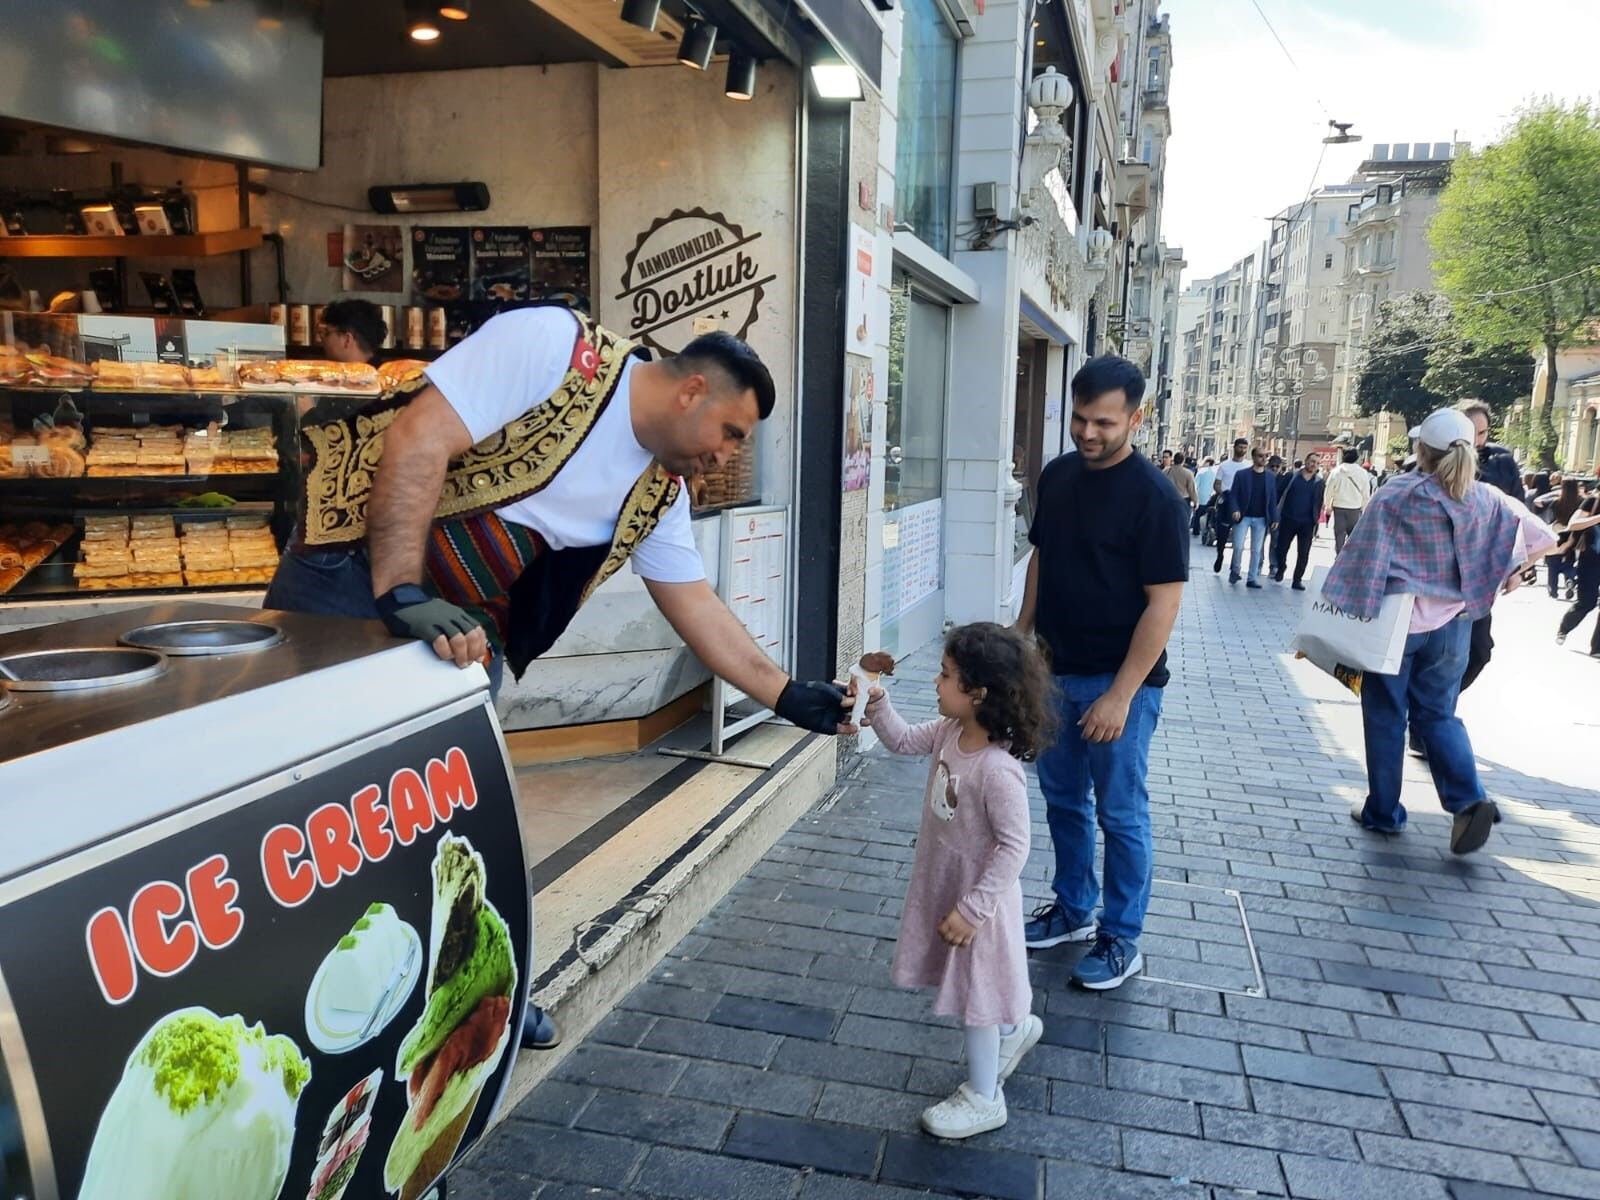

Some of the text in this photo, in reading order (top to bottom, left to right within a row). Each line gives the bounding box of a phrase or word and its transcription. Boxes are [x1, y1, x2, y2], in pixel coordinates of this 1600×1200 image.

[630, 251, 759, 329] Dostluk
[637, 228, 724, 279] HAMURUMUZDA
[85, 746, 477, 1005] ICE CREAM
